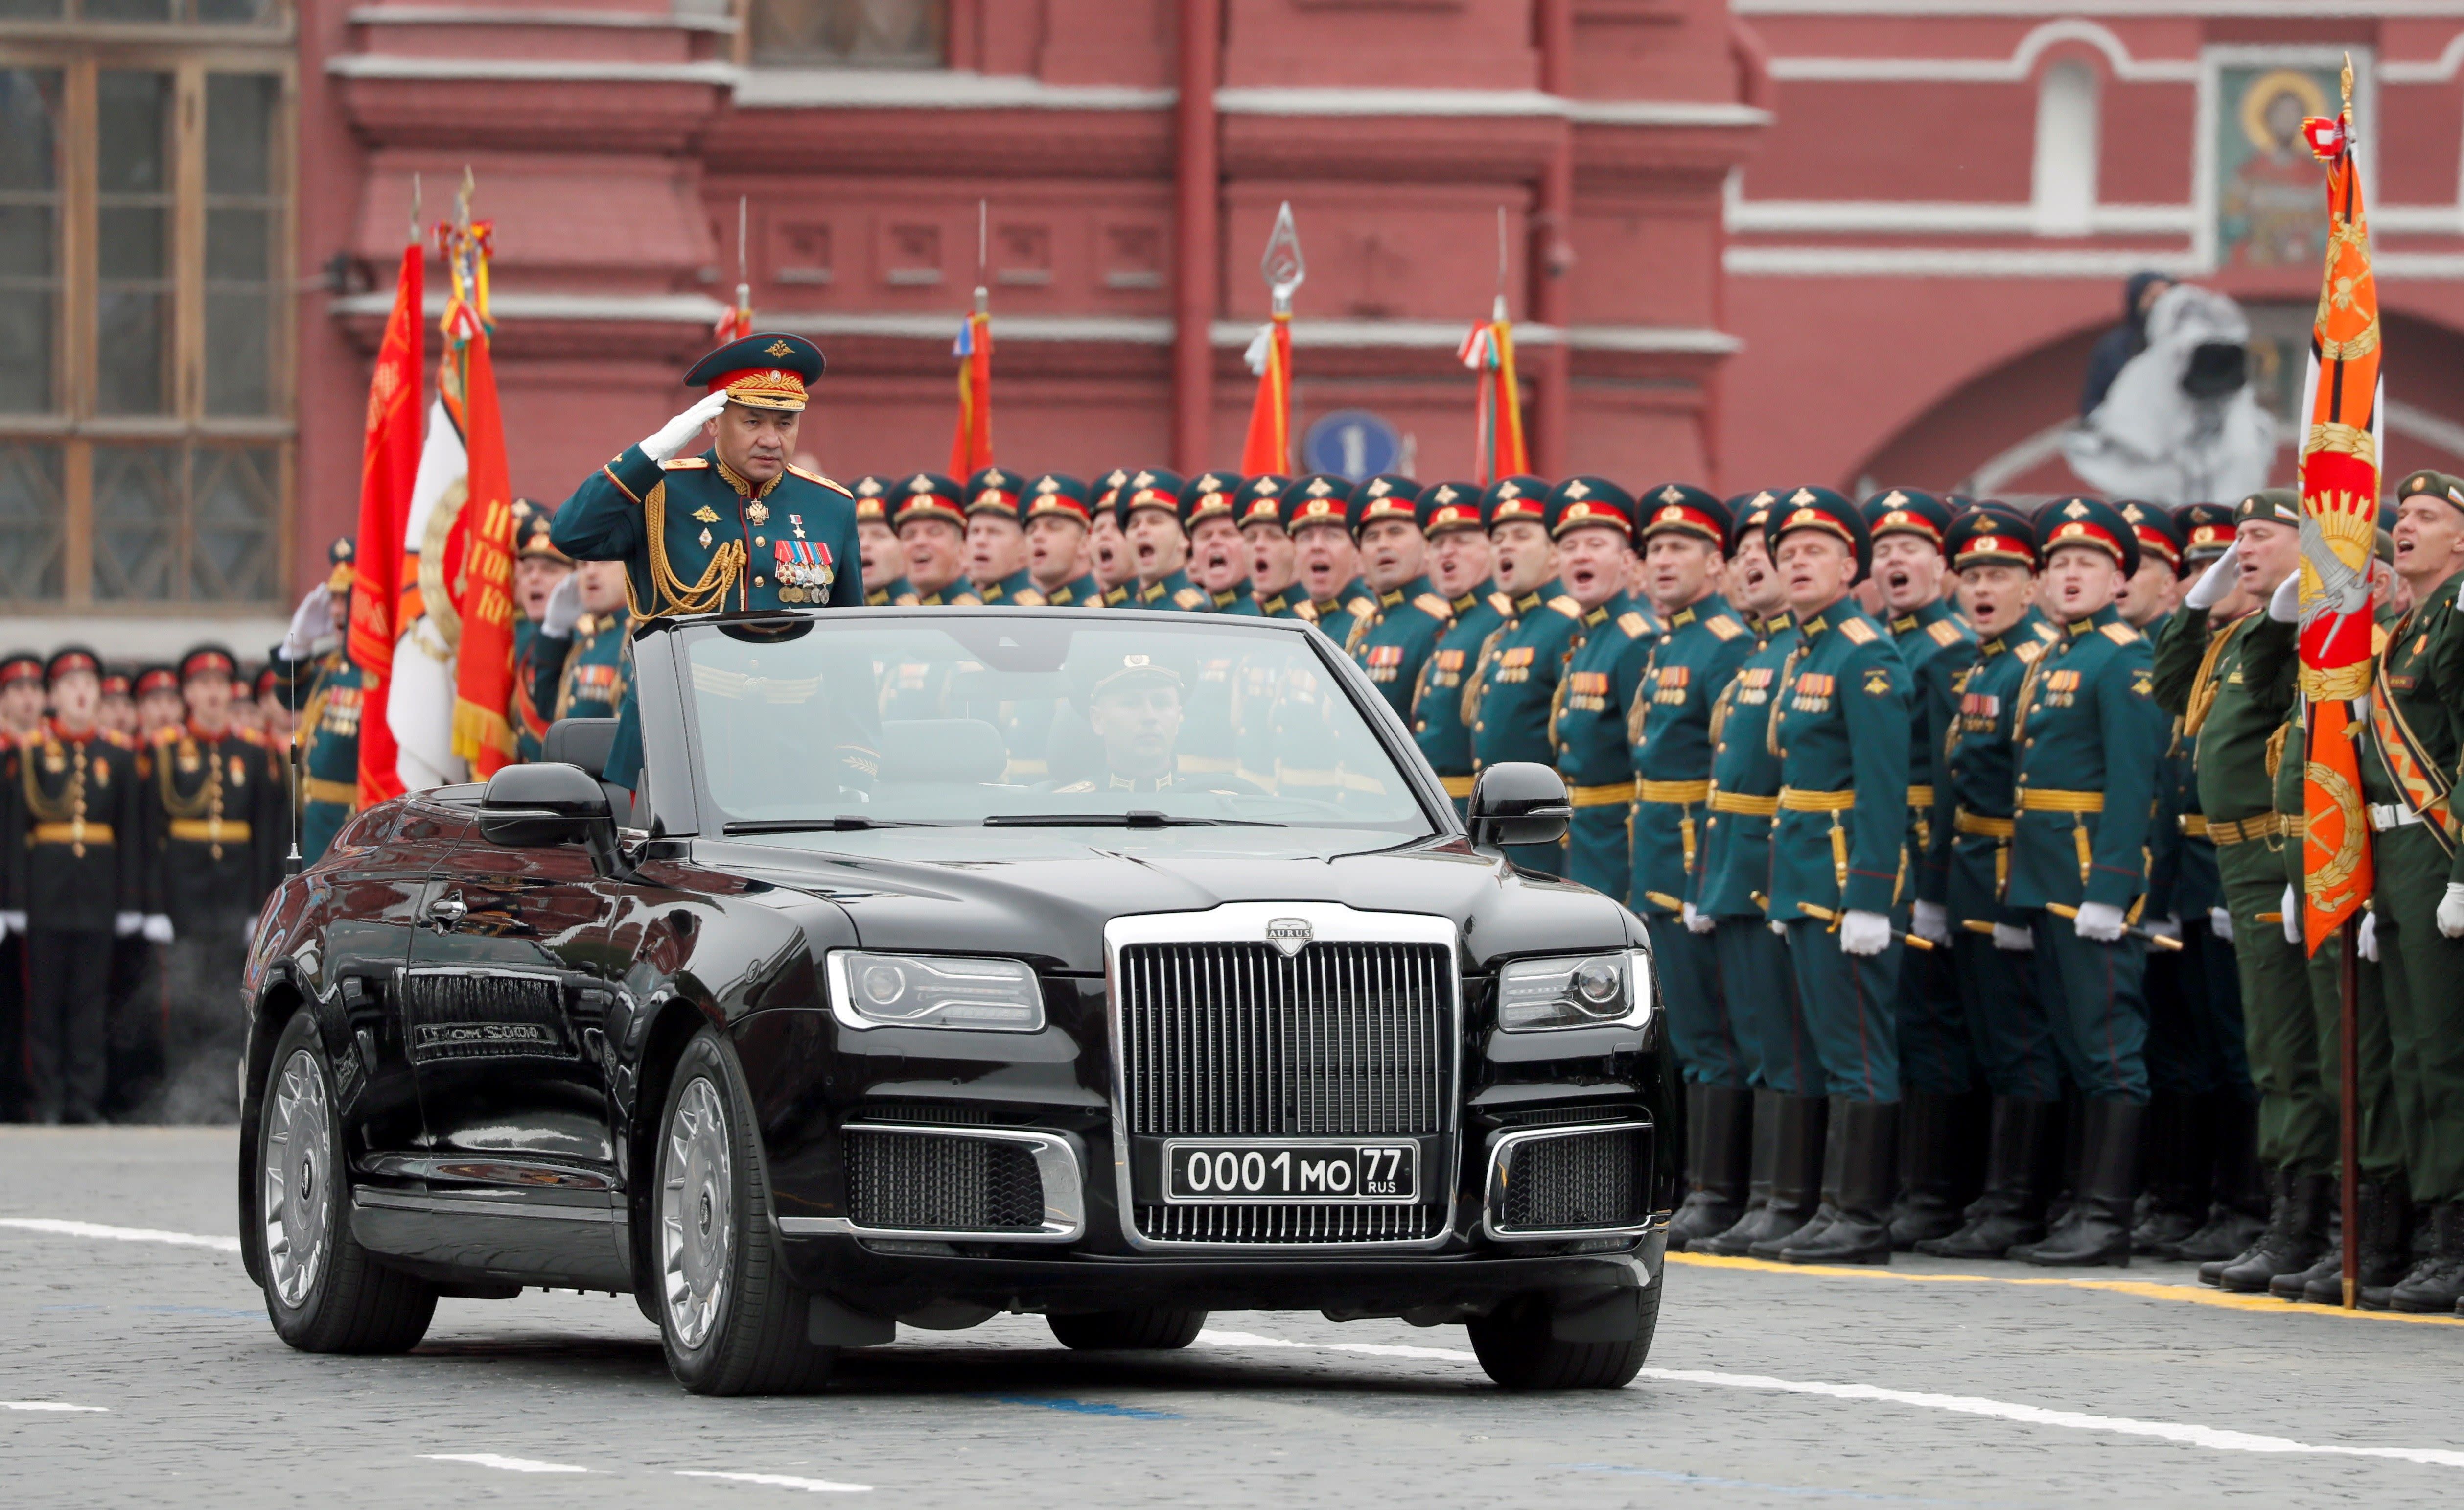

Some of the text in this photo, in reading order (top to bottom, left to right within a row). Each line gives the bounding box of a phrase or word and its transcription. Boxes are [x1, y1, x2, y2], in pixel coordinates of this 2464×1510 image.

[1340, 425, 1366, 480] 1
[1188, 1152, 1290, 1191] 0001
[1363, 1149, 1401, 1180] 77
[1368, 1182, 1396, 1193] RUS
